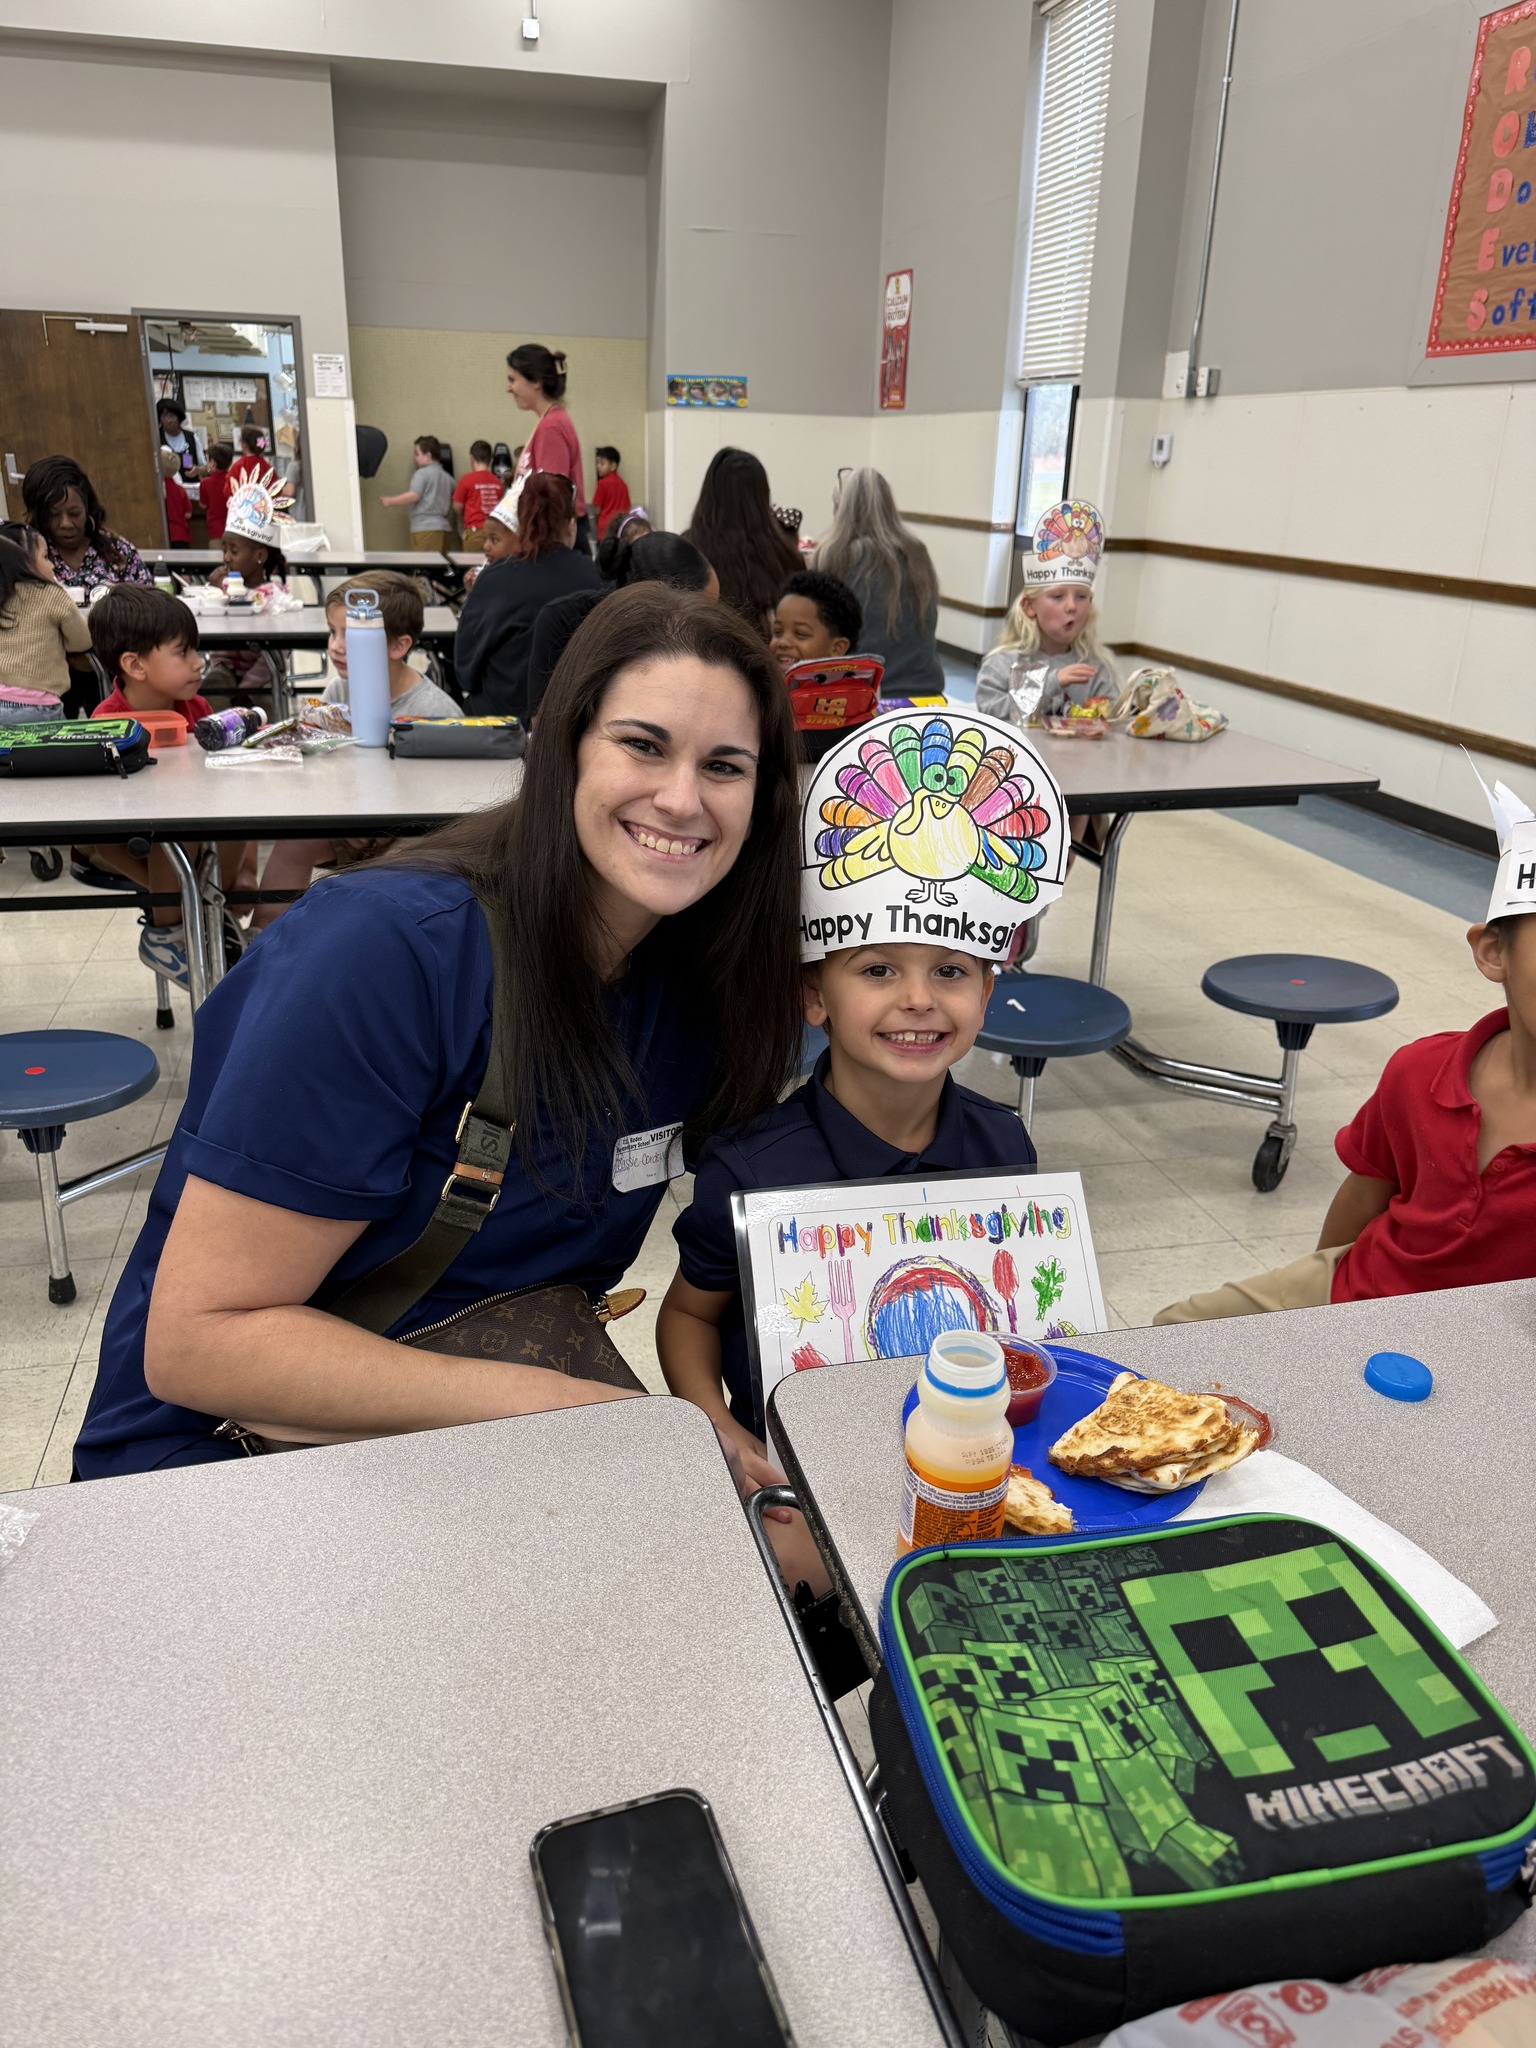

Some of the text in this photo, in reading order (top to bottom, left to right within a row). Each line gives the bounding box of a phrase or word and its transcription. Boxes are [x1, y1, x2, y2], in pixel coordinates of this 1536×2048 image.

[1026, 569, 1058, 581] Happy
[776, 1200, 1071, 1260] Happy Thanksgiving
[1246, 1735, 1524, 1831] MINECRAFT
